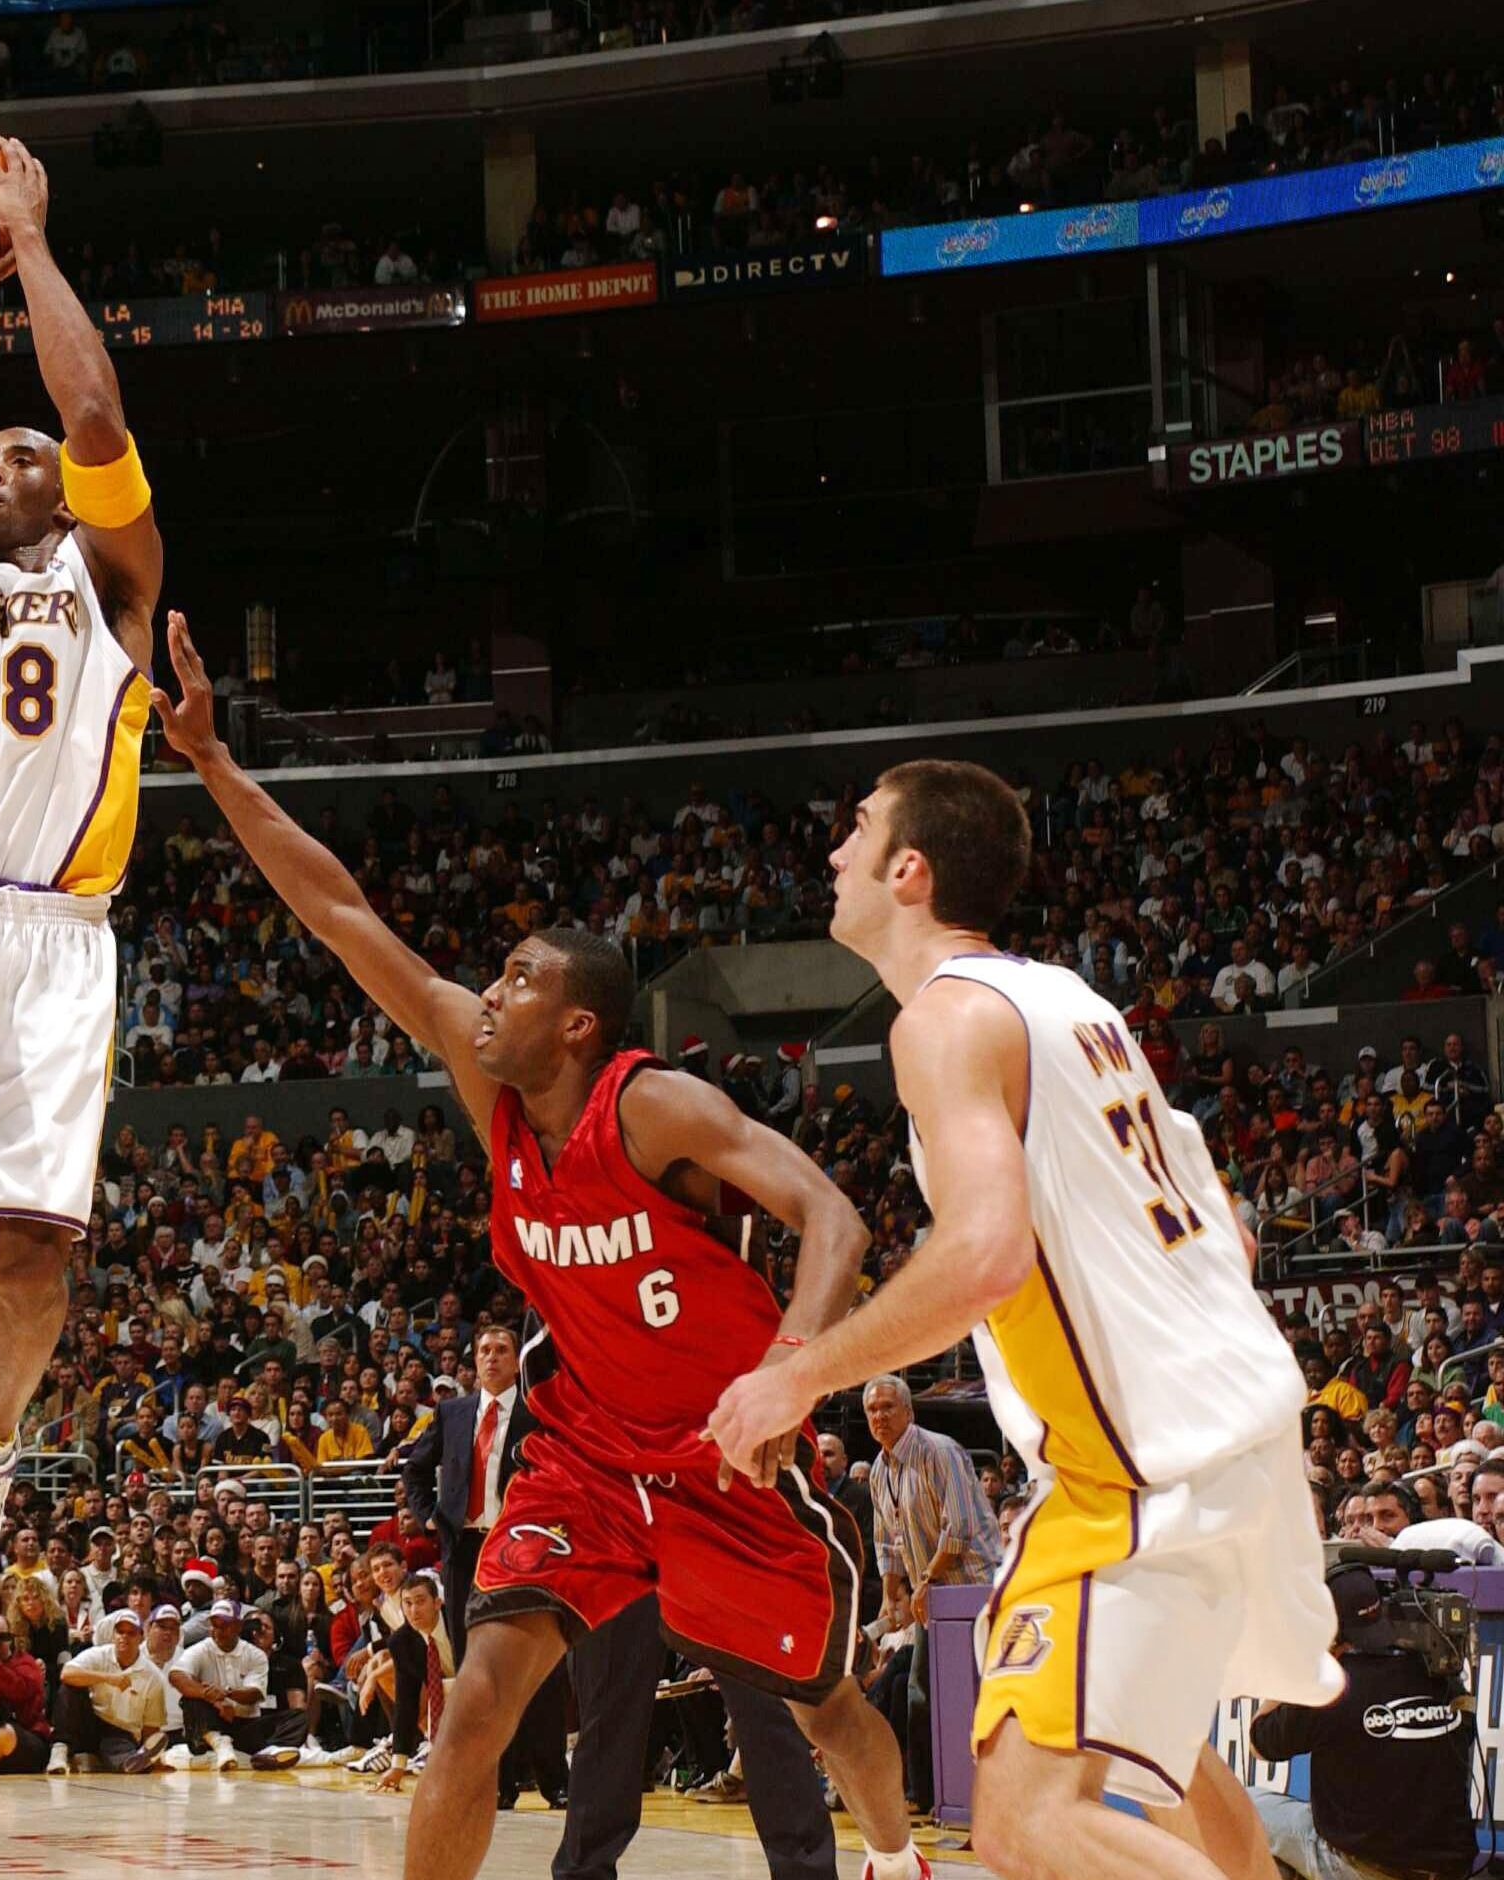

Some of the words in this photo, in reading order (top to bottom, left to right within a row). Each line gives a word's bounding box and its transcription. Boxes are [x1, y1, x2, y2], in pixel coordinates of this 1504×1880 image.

[712, 250, 850, 283] DIRECTV
[316, 300, 425, 319] McDonald's
[481, 290, 523, 310] THE
[526, 281, 583, 306] HOME
[587, 275, 653, 298] DEPOT
[104, 304, 131, 323] LA
[206, 297, 245, 316] MIA
[130, 326, 152, 346] 15
[193, 322, 213, 341] 14
[240, 320, 263, 338] 20
[1188, 428, 1344, 484] STAPLES
[2, 641, 58, 742] 8
[1364, 697, 1386, 715] 219
[1102, 1090, 1207, 1252] 31
[514, 1210, 654, 1267] MIAMI
[637, 1268, 681, 1329] 6
[1364, 1713, 1394, 1729] abc
